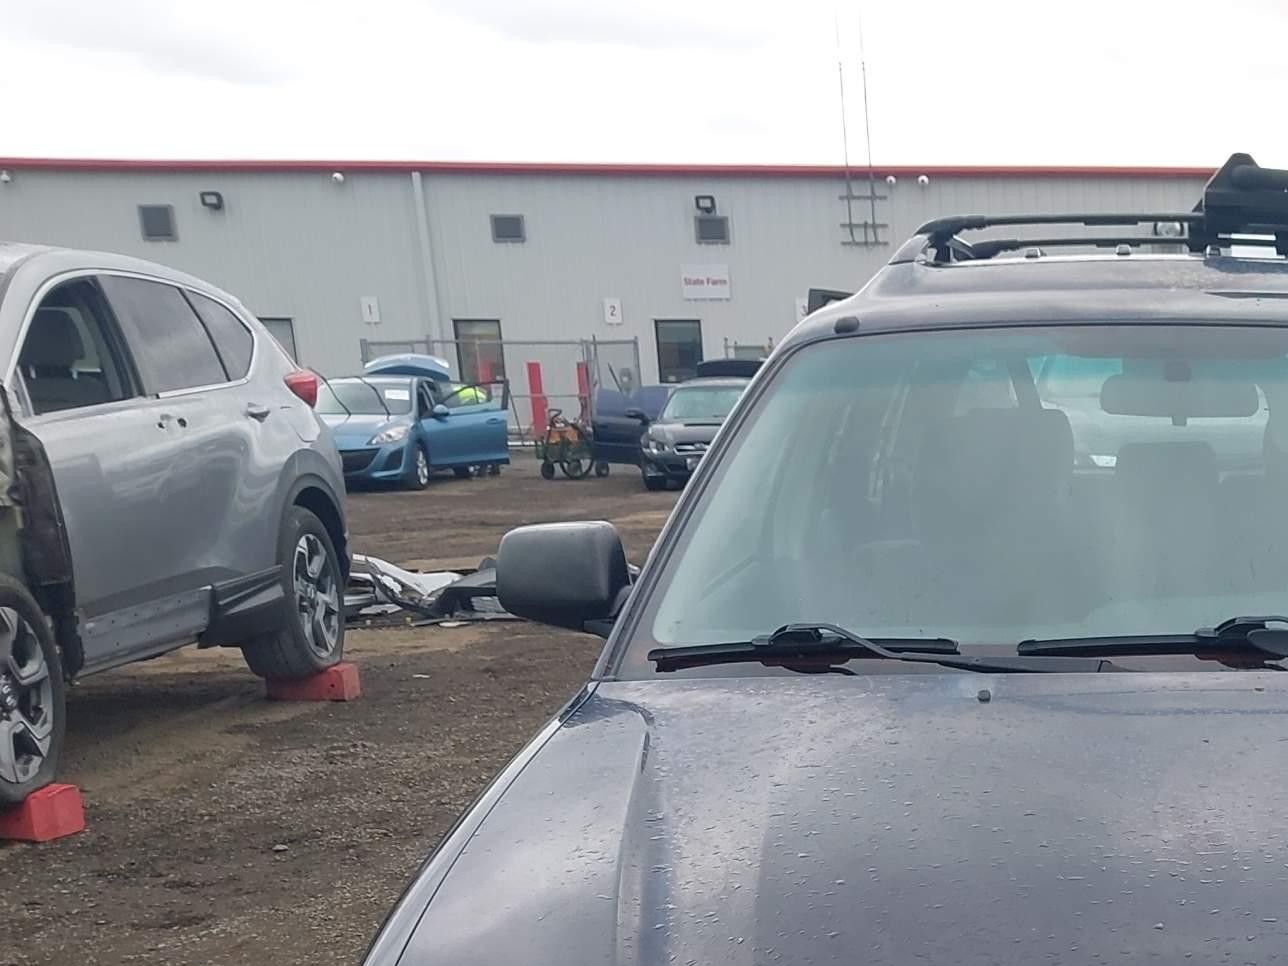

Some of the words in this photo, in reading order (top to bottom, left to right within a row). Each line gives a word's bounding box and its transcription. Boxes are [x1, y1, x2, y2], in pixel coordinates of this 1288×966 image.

[683, 277, 704, 286] State
[706, 277, 728, 286] Farm
[609, 305, 617, 317] 2
